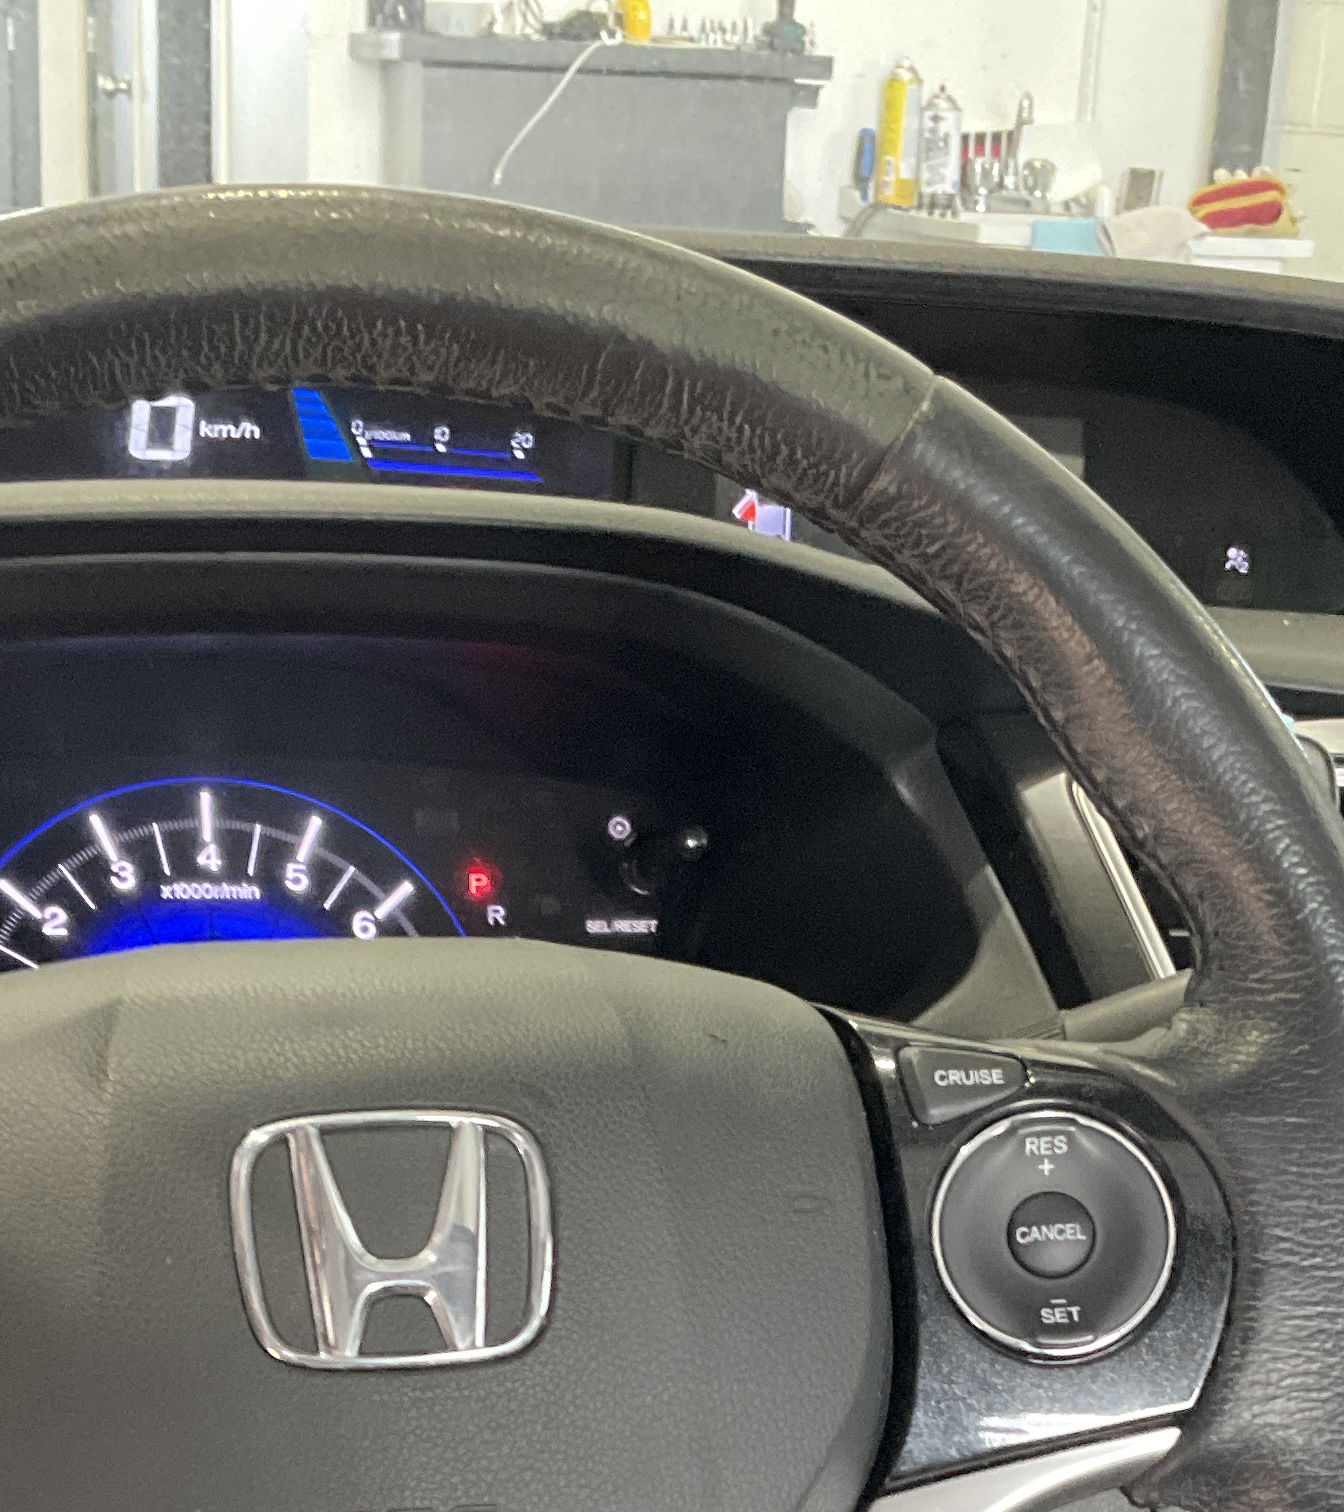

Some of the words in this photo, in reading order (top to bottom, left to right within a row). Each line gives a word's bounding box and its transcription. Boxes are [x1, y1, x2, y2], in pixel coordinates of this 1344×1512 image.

[128, 395, 196, 461] 0
[198, 419, 262, 440] km/h
[196, 842, 223, 872] 4
[109, 859, 136, 890] 3
[284, 861, 309, 893] 5
[467, 871, 492, 896] P
[41, 905, 69, 937] 2
[351, 910, 378, 941] 6
[486, 903, 507, 926] R
[932, 1068, 1005, 1087] CRUISE
[1023, 1135, 1069, 1156] RES
[1014, 1223, 1087, 1244] CANCEL
[1039, 1304, 1082, 1324] SET
